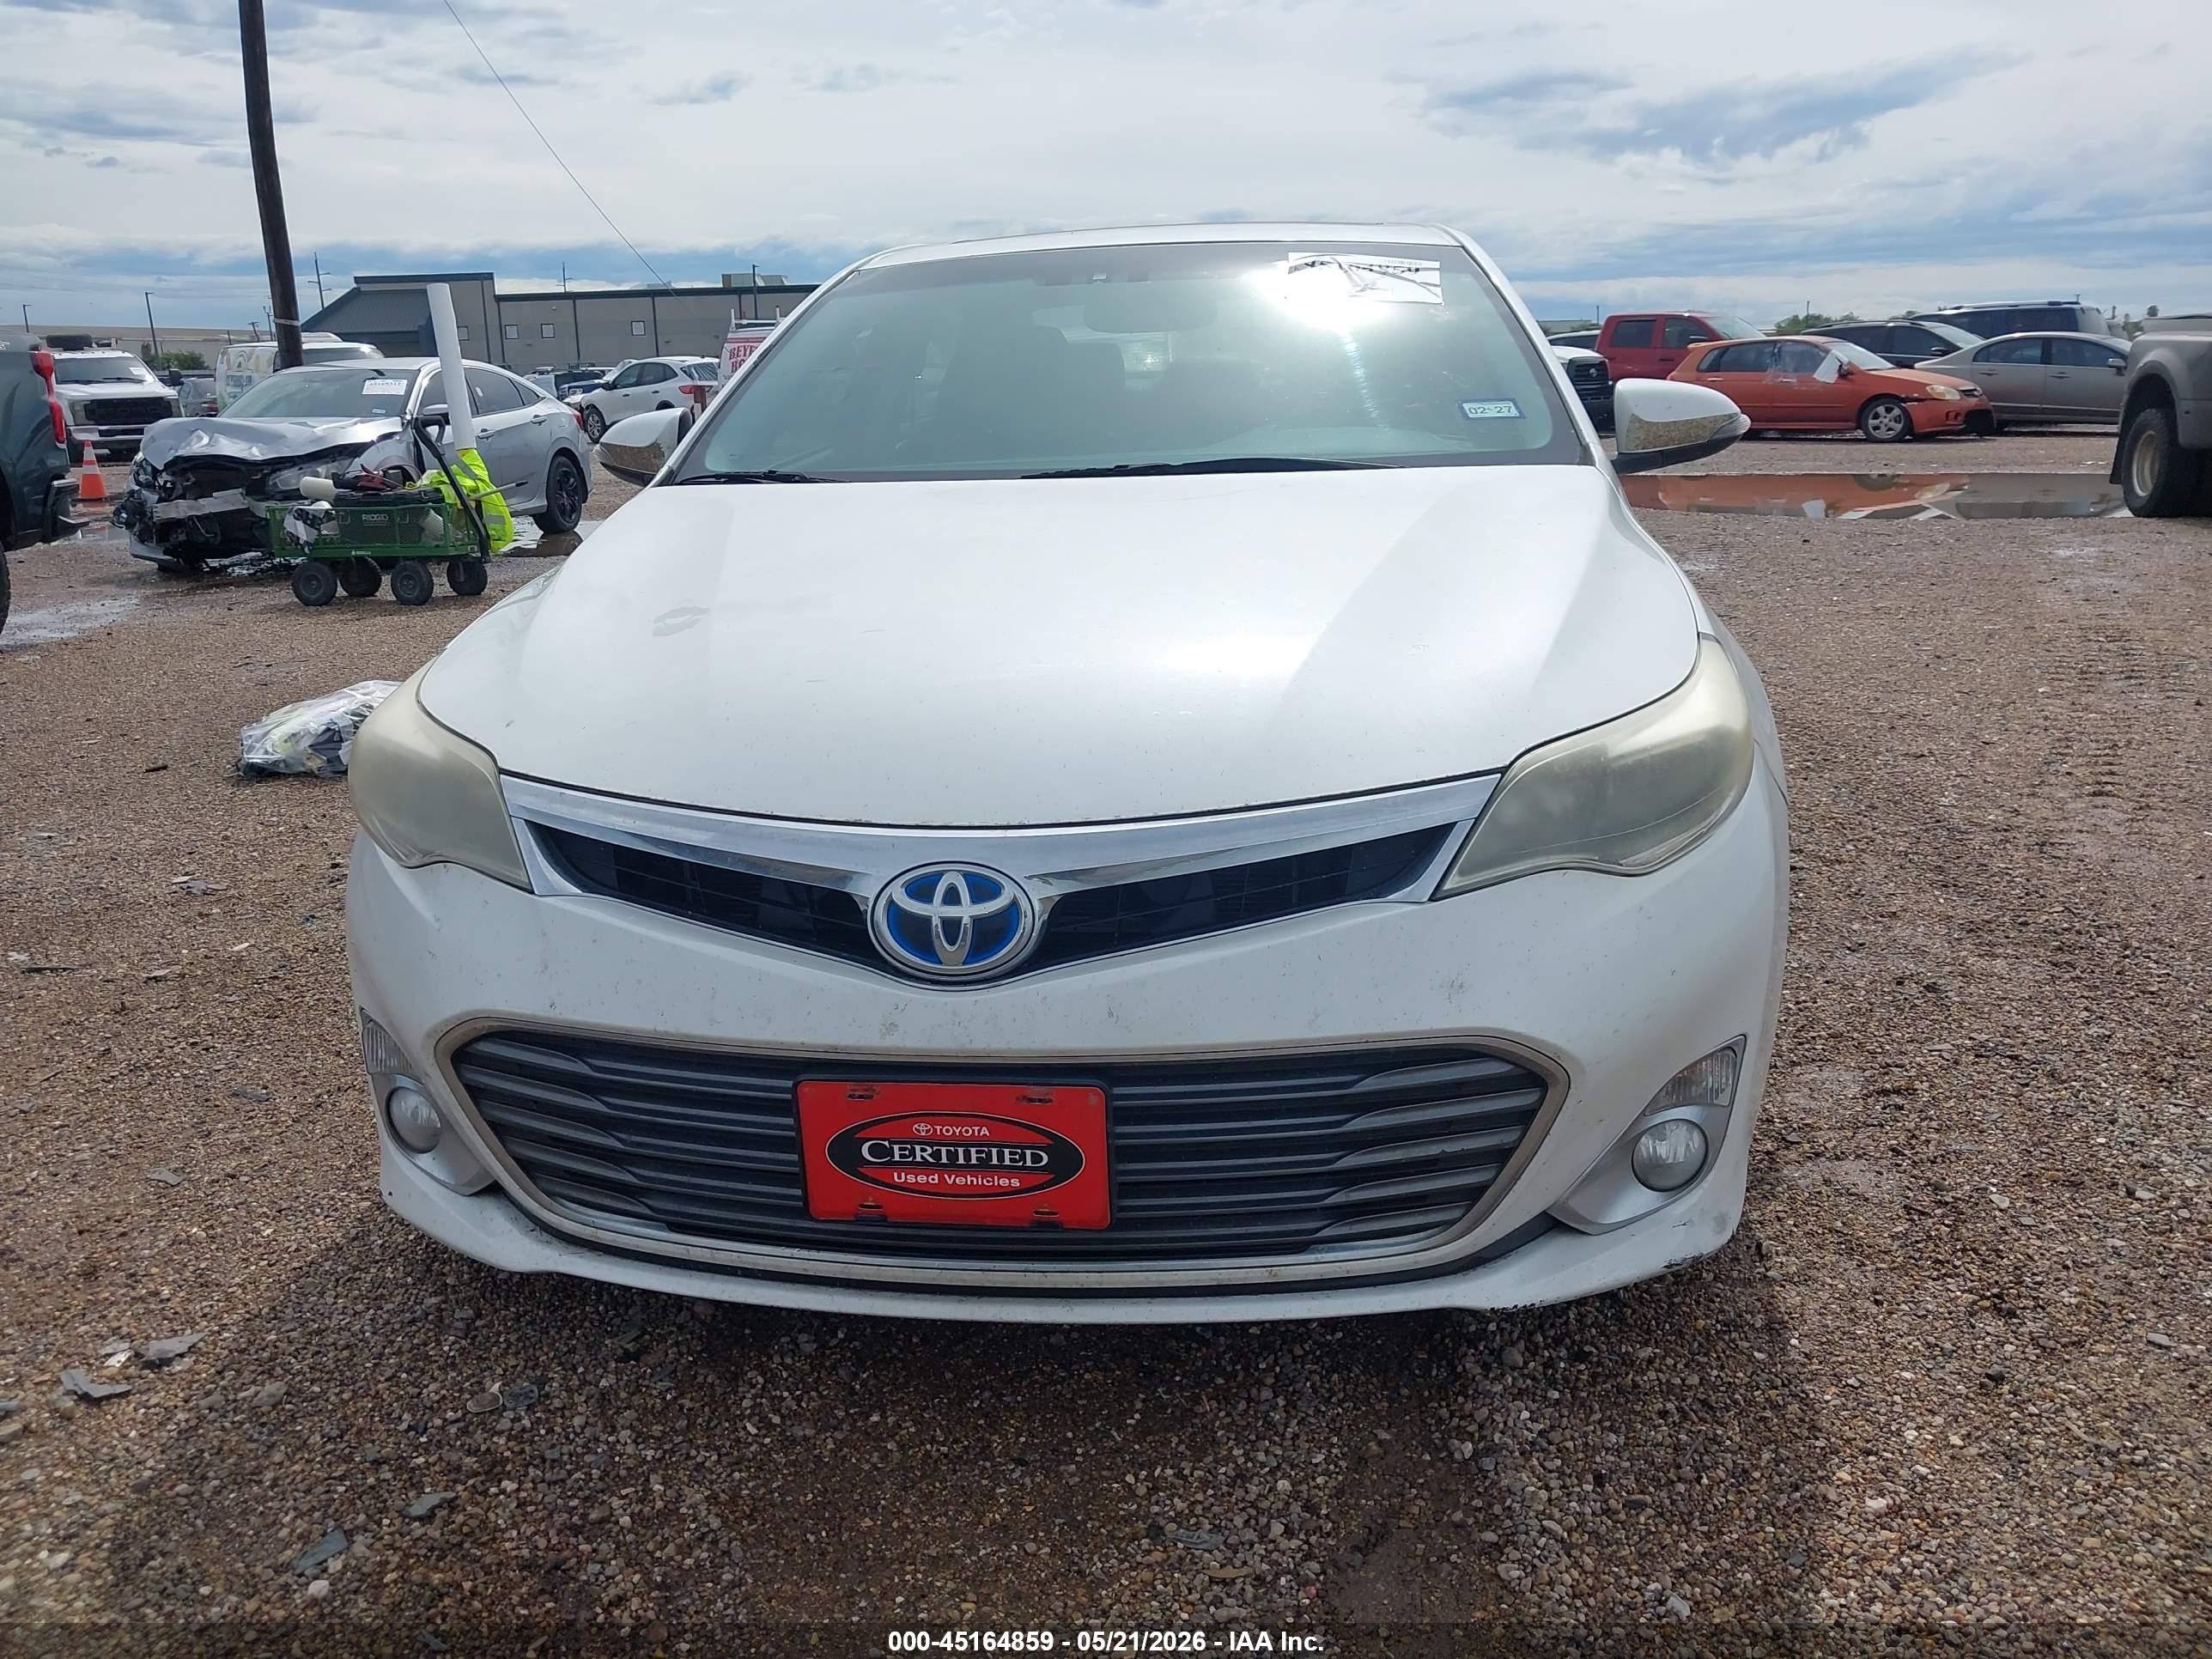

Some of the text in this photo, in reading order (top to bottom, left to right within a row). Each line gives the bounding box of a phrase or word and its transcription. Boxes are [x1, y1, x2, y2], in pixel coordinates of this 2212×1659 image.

[934, 1125, 990, 1138] TOYOTA
[860, 1139, 1049, 1168] CERTIFIED
[893, 1171, 1021, 1188] Used Vehicles
